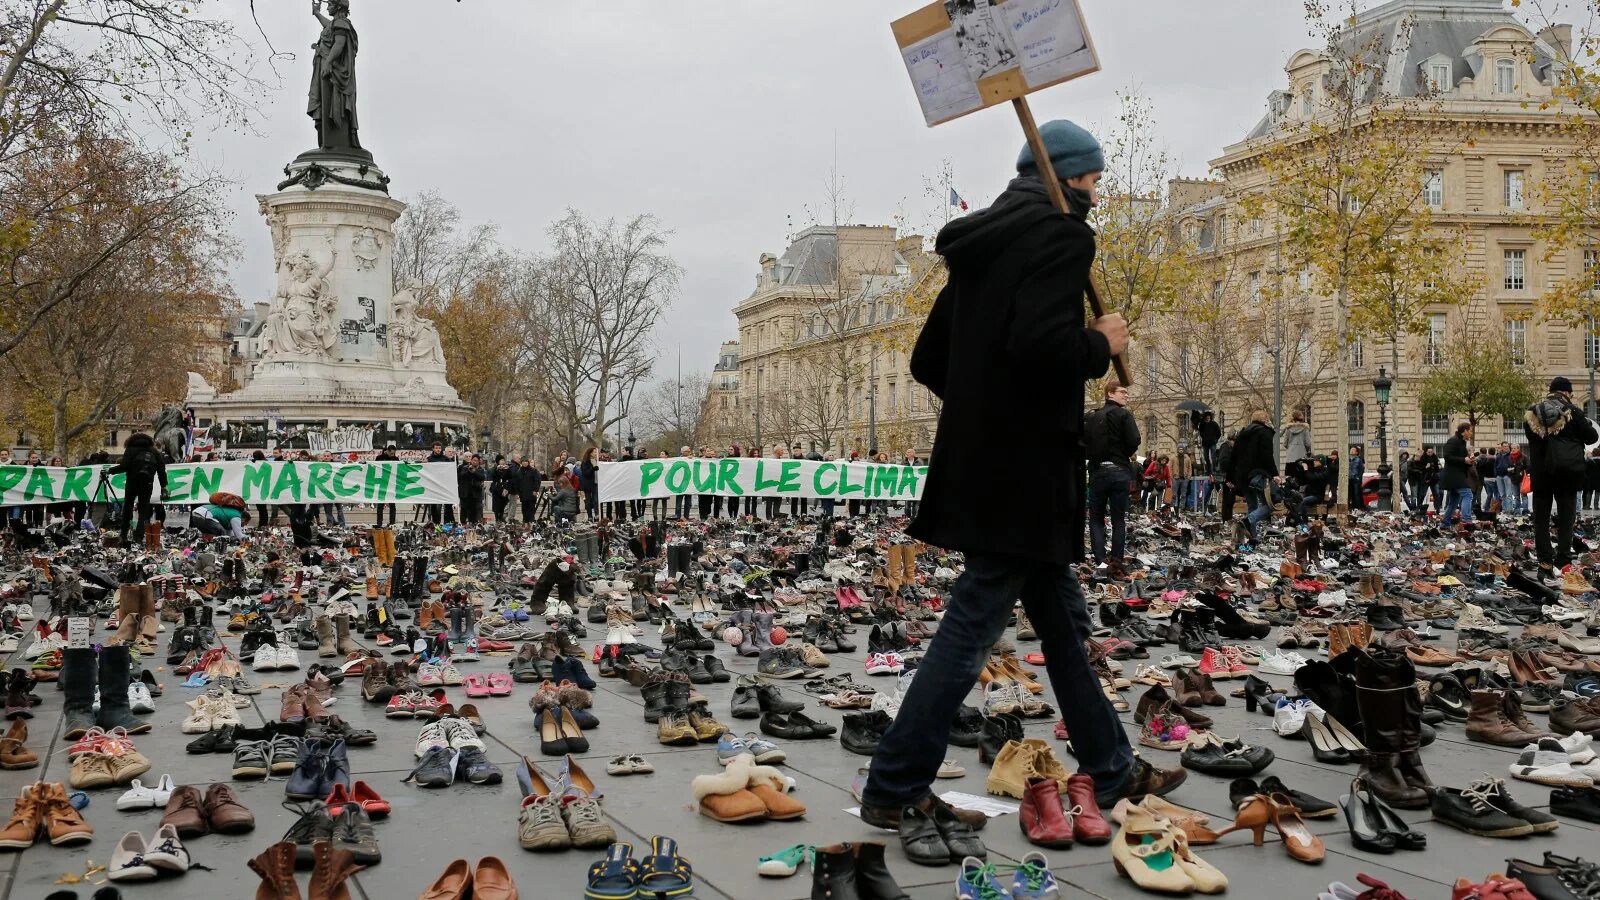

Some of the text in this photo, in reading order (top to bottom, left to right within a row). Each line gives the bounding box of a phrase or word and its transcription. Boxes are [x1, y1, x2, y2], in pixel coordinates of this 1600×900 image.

[166, 467, 224, 502] EN
[242, 461, 426, 502] MARCHE
[640, 458, 744, 497] POUR
[754, 460, 801, 492] LE
